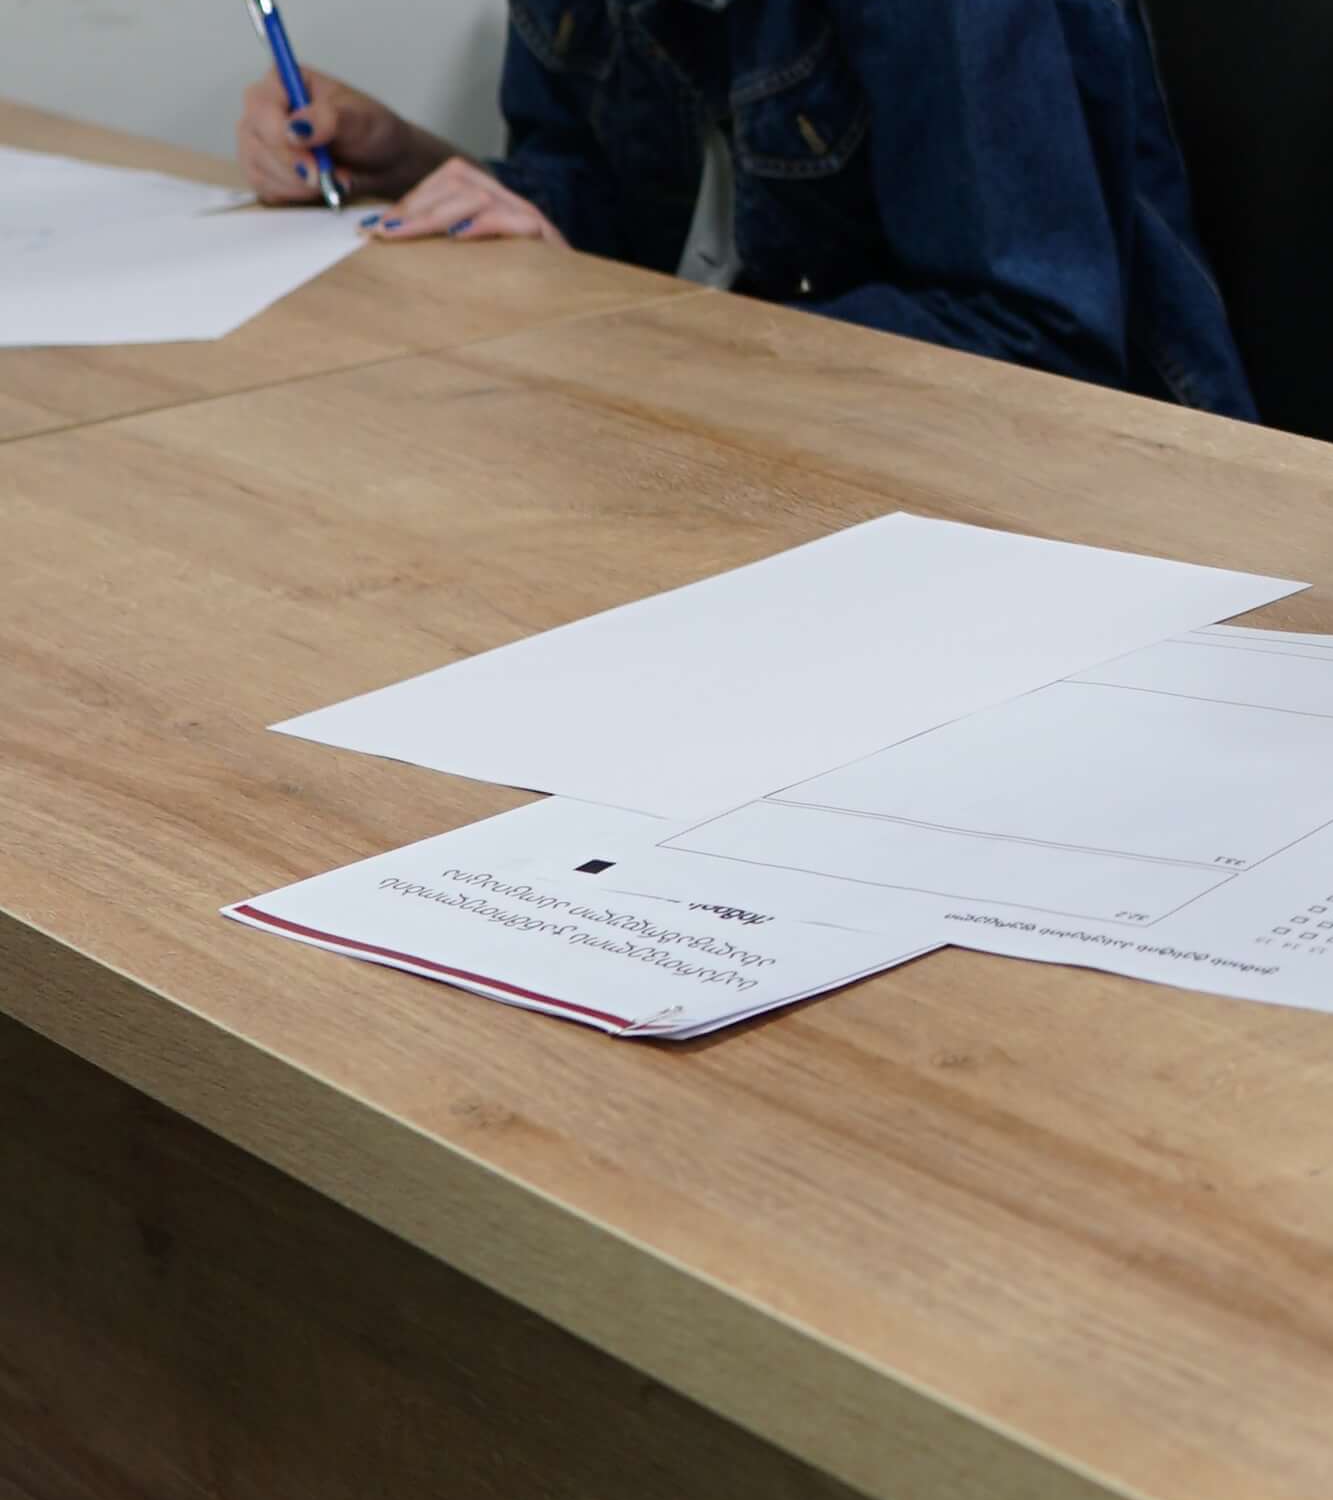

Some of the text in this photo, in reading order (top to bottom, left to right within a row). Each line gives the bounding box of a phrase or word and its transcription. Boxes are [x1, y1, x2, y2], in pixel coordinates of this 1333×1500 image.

[378, 876, 760, 992] საქართველოს ჯანმრთელობის
[441, 868, 777, 968] ახალგაზრდული ასოციაცია
